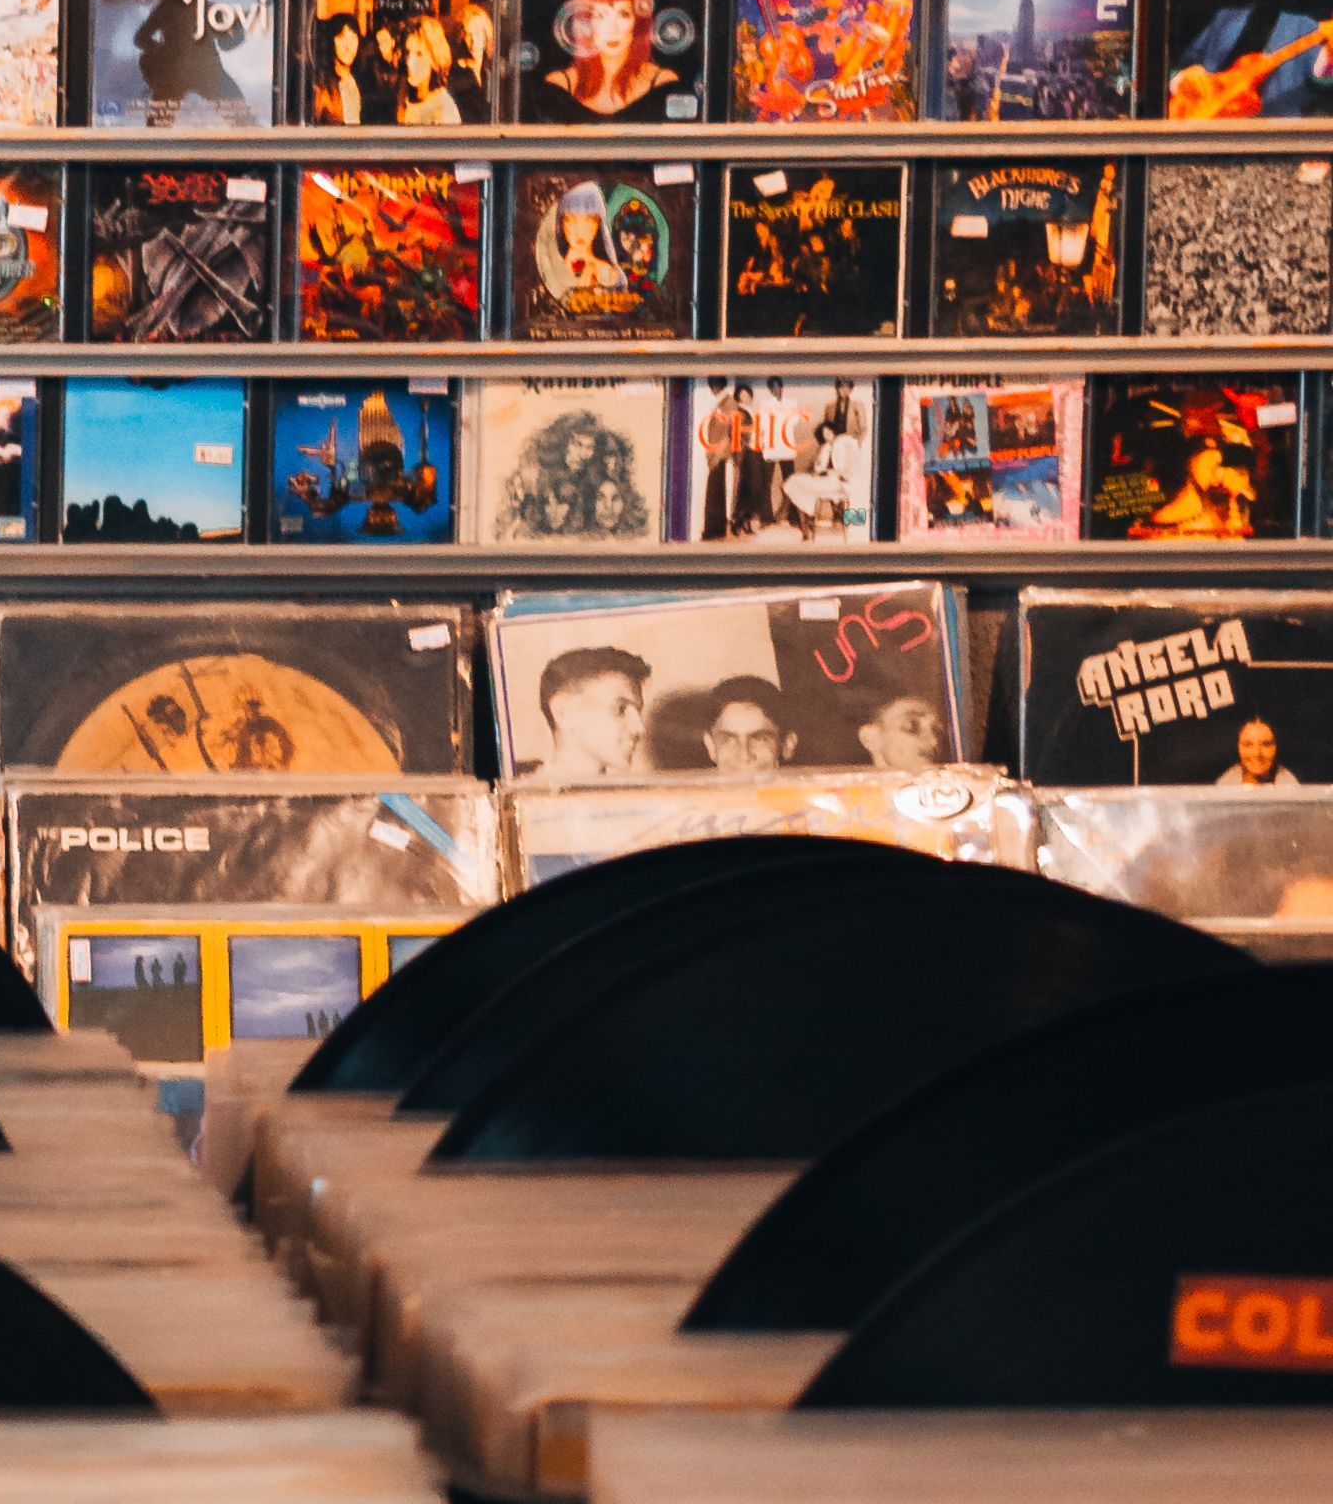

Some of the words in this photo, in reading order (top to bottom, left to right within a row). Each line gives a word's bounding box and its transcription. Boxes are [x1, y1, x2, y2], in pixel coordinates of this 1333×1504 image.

[699, 407, 813, 456] CHIC
[1078, 619, 1251, 708] ANGELA
[1112, 669, 1235, 743] RORO
[60, 826, 210, 854] POLICE
